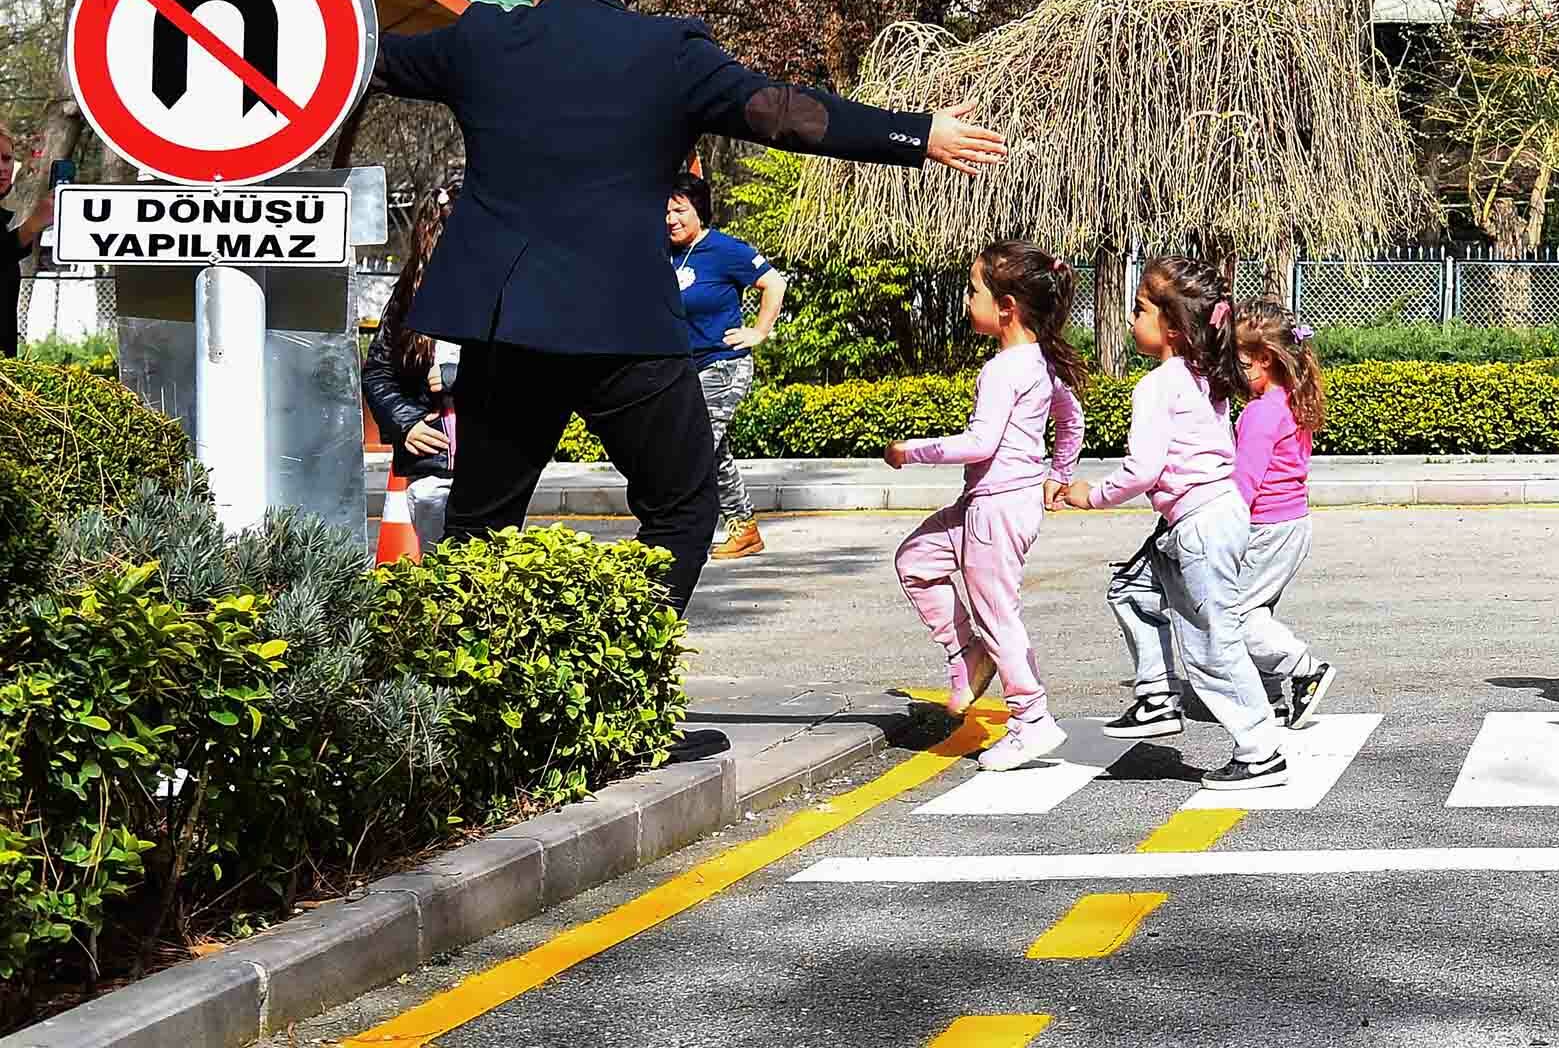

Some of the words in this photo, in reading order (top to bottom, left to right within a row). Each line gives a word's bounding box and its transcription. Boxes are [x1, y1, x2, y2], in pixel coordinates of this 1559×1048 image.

[83, 198, 111, 224] U
[136, 194, 325, 228] DÖNÜŞÜ
[90, 233, 316, 258] YAPILMAZ
